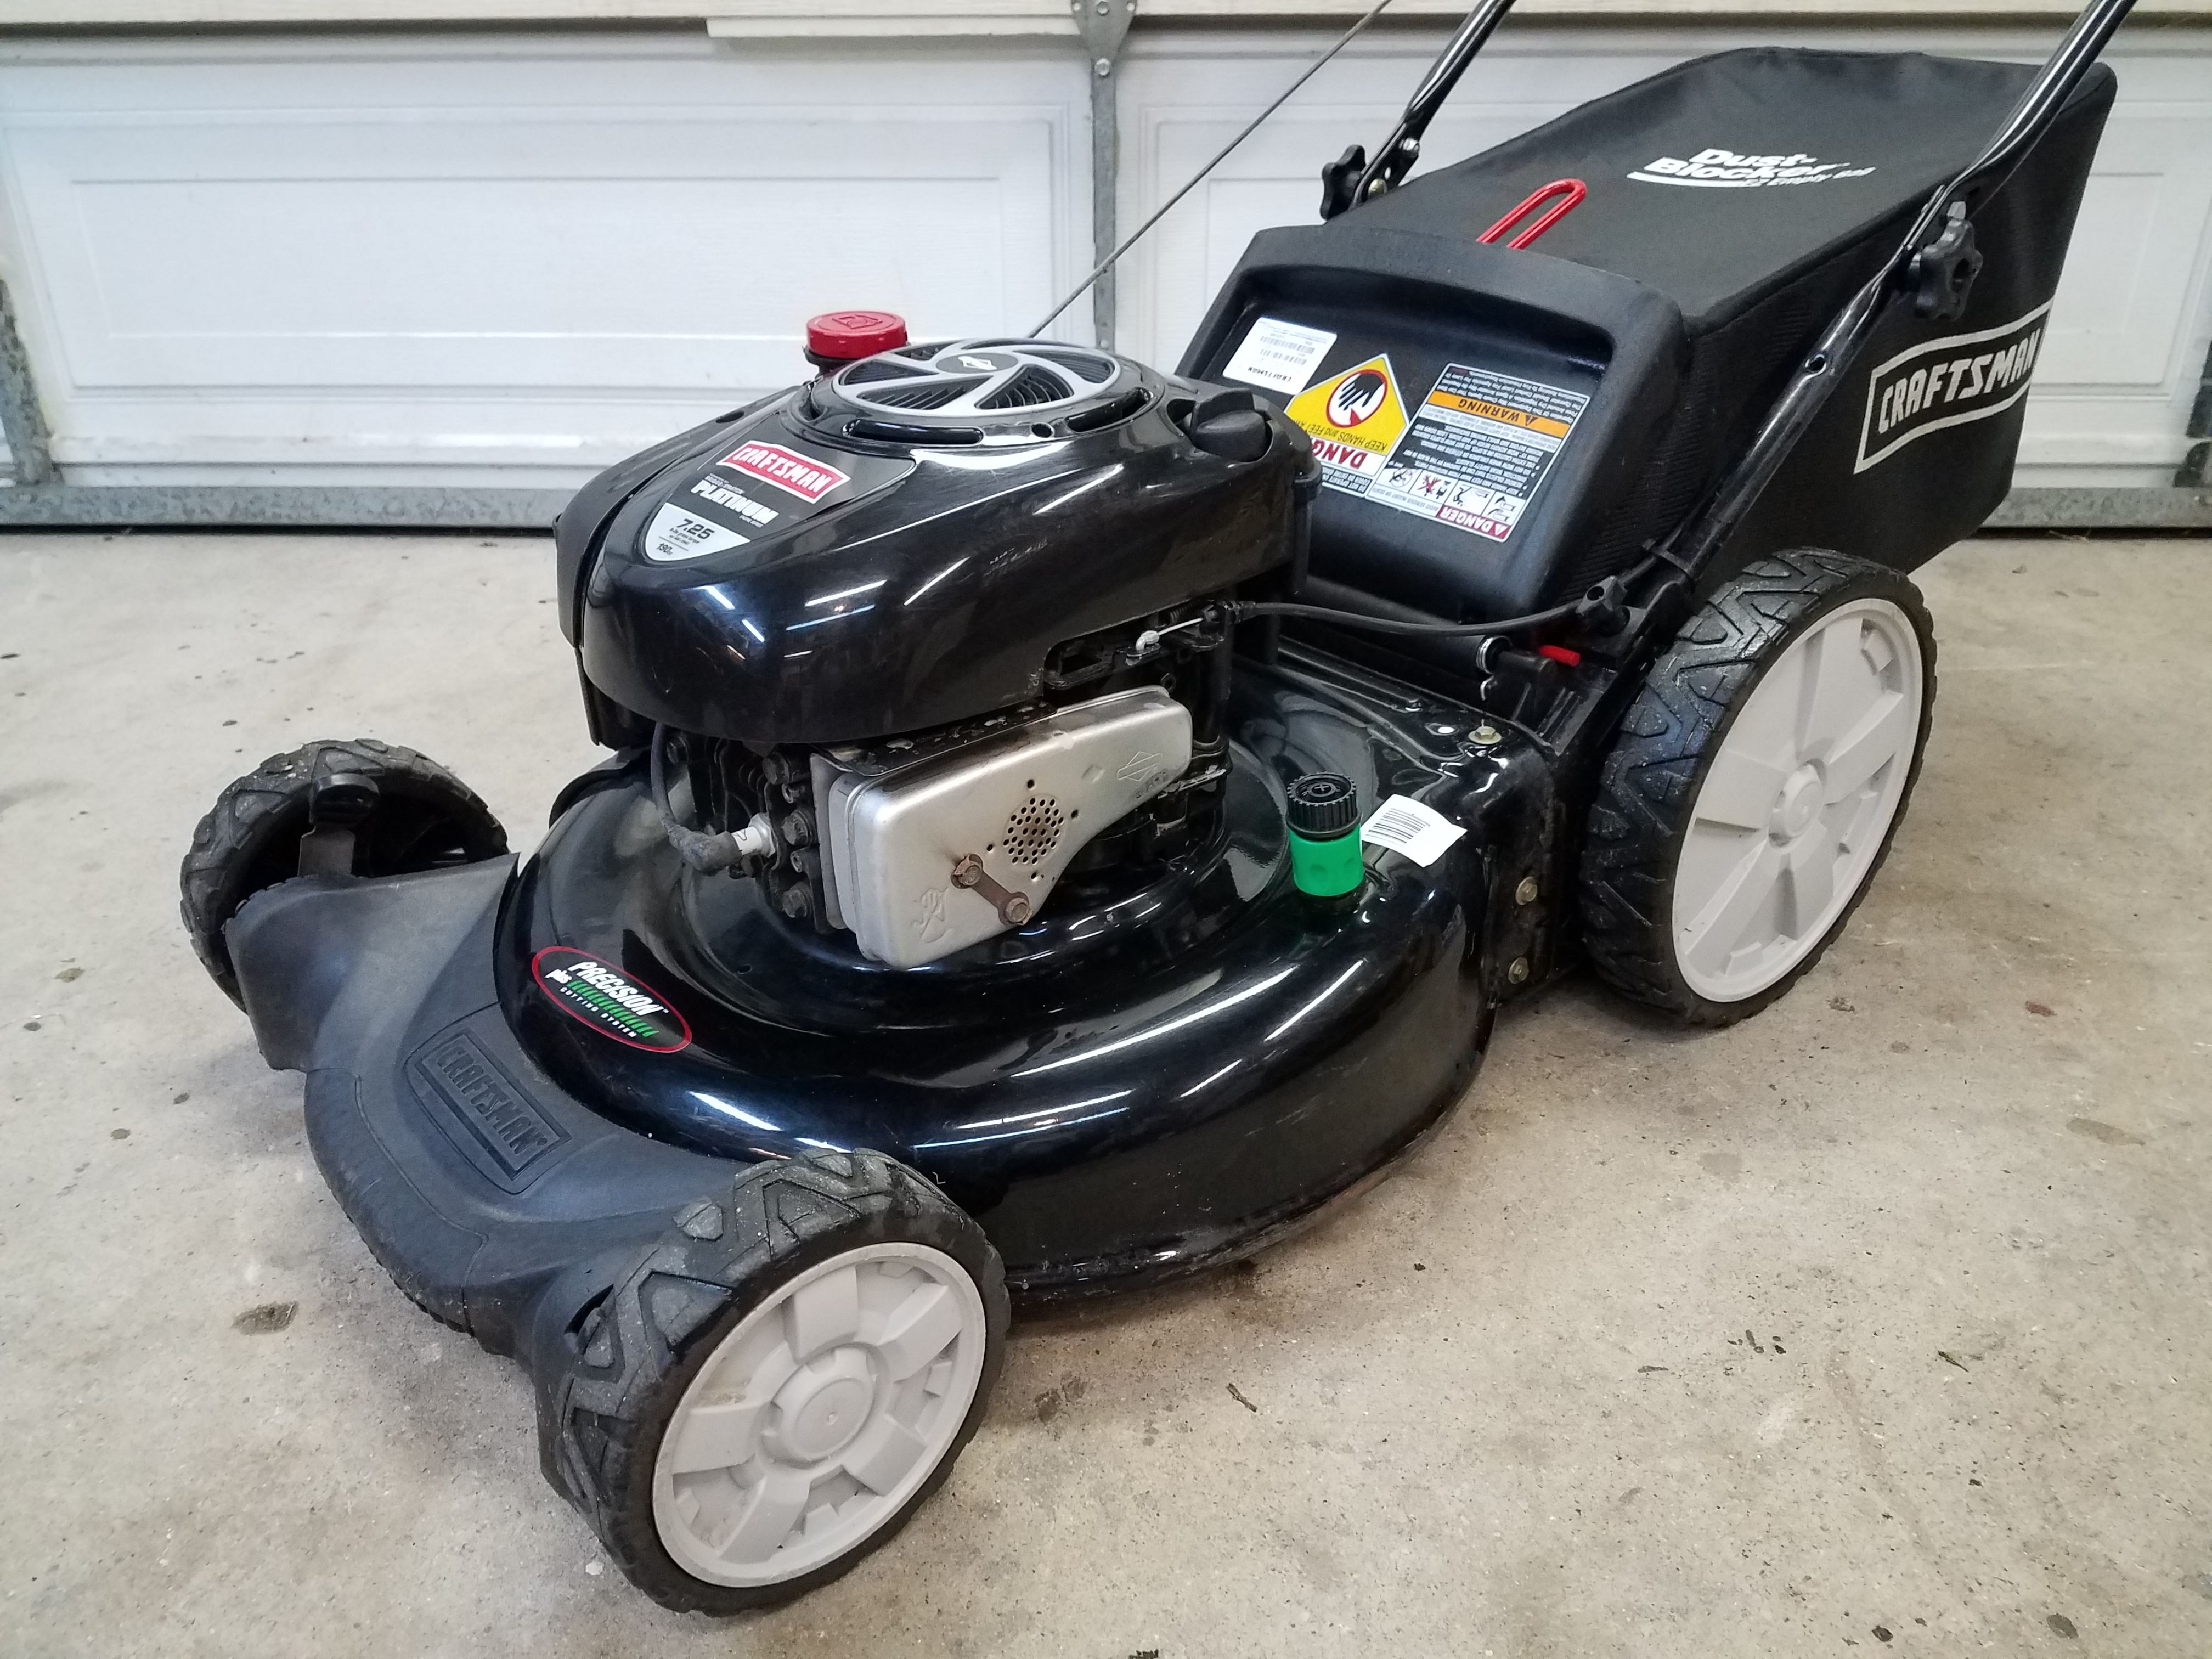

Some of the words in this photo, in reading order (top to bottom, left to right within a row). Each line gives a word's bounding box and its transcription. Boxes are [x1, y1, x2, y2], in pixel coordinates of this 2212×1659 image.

[1644, 157, 1851, 179] Blocker
[1689, 148, 1818, 167] Dust-
[1248, 366, 1292, 382] CRAFTSMAN
[1878, 327, 2041, 435] CRAFTSMAN
[1457, 398, 1521, 421] WARNING
[1325, 427, 1337, 437] and
[1338, 432, 1364, 446] HANDS
[1312, 439, 1368, 469] DANG
[1365, 441, 1387, 452] KEEP
[732, 446, 833, 493] CRAFTSMAN
[690, 479, 780, 524] PLATINUM
[676, 518, 715, 539] 7.25
[1438, 505, 1495, 532] DANGER
[544, 968, 573, 985] plus
[567, 961, 663, 1017] PRECISION
[560, 986, 599, 1013] CUTTING
[600, 1012, 638, 1038] SYSTEM
[436, 1045, 544, 1155] CRAFTSMAN
